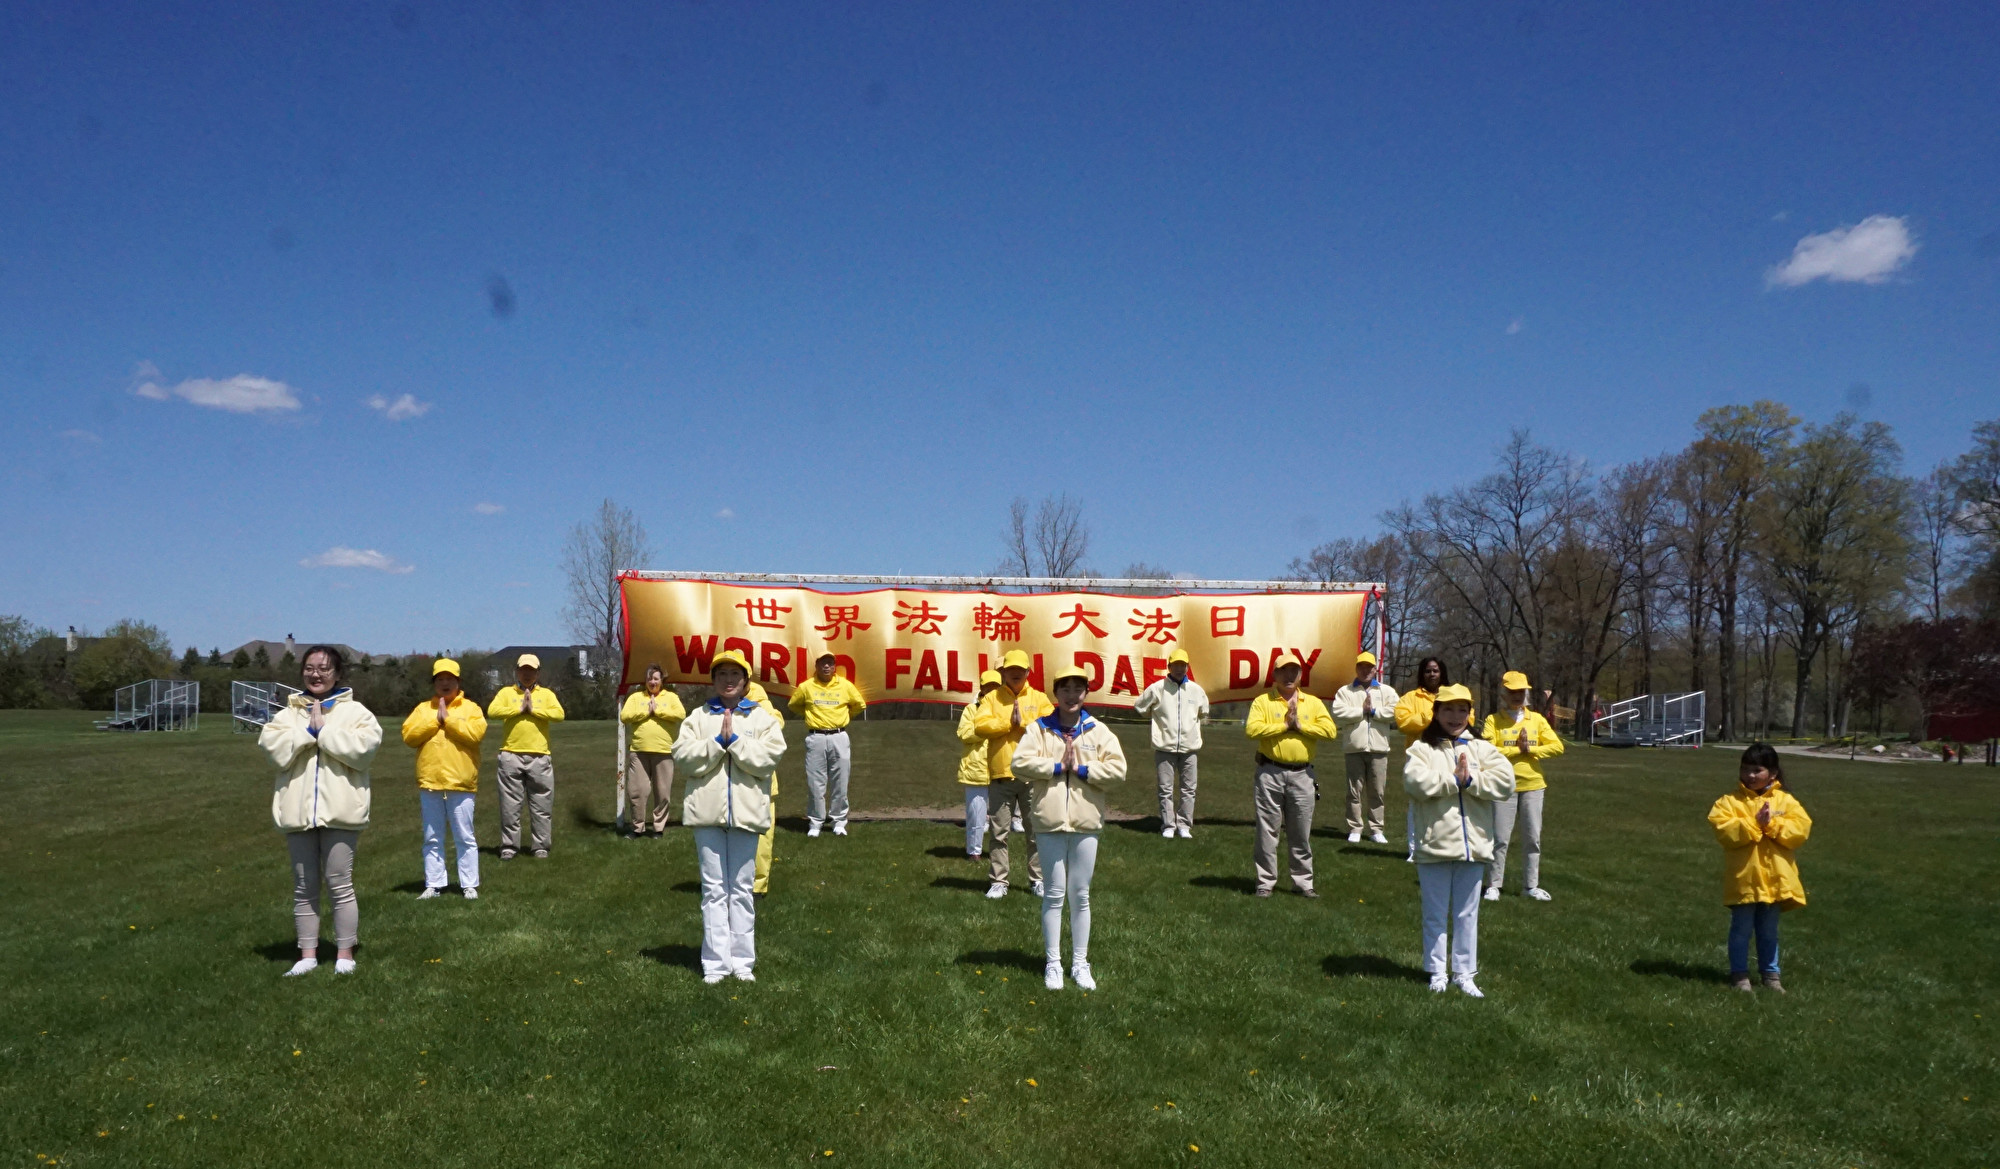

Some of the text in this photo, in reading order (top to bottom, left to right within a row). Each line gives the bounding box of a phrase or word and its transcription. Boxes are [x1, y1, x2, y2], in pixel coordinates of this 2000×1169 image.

[735, 597, 1246, 645] 世界法輪大法日
[885, 647, 1046, 693] FALN
[1073, 651, 1196, 696] DAF
